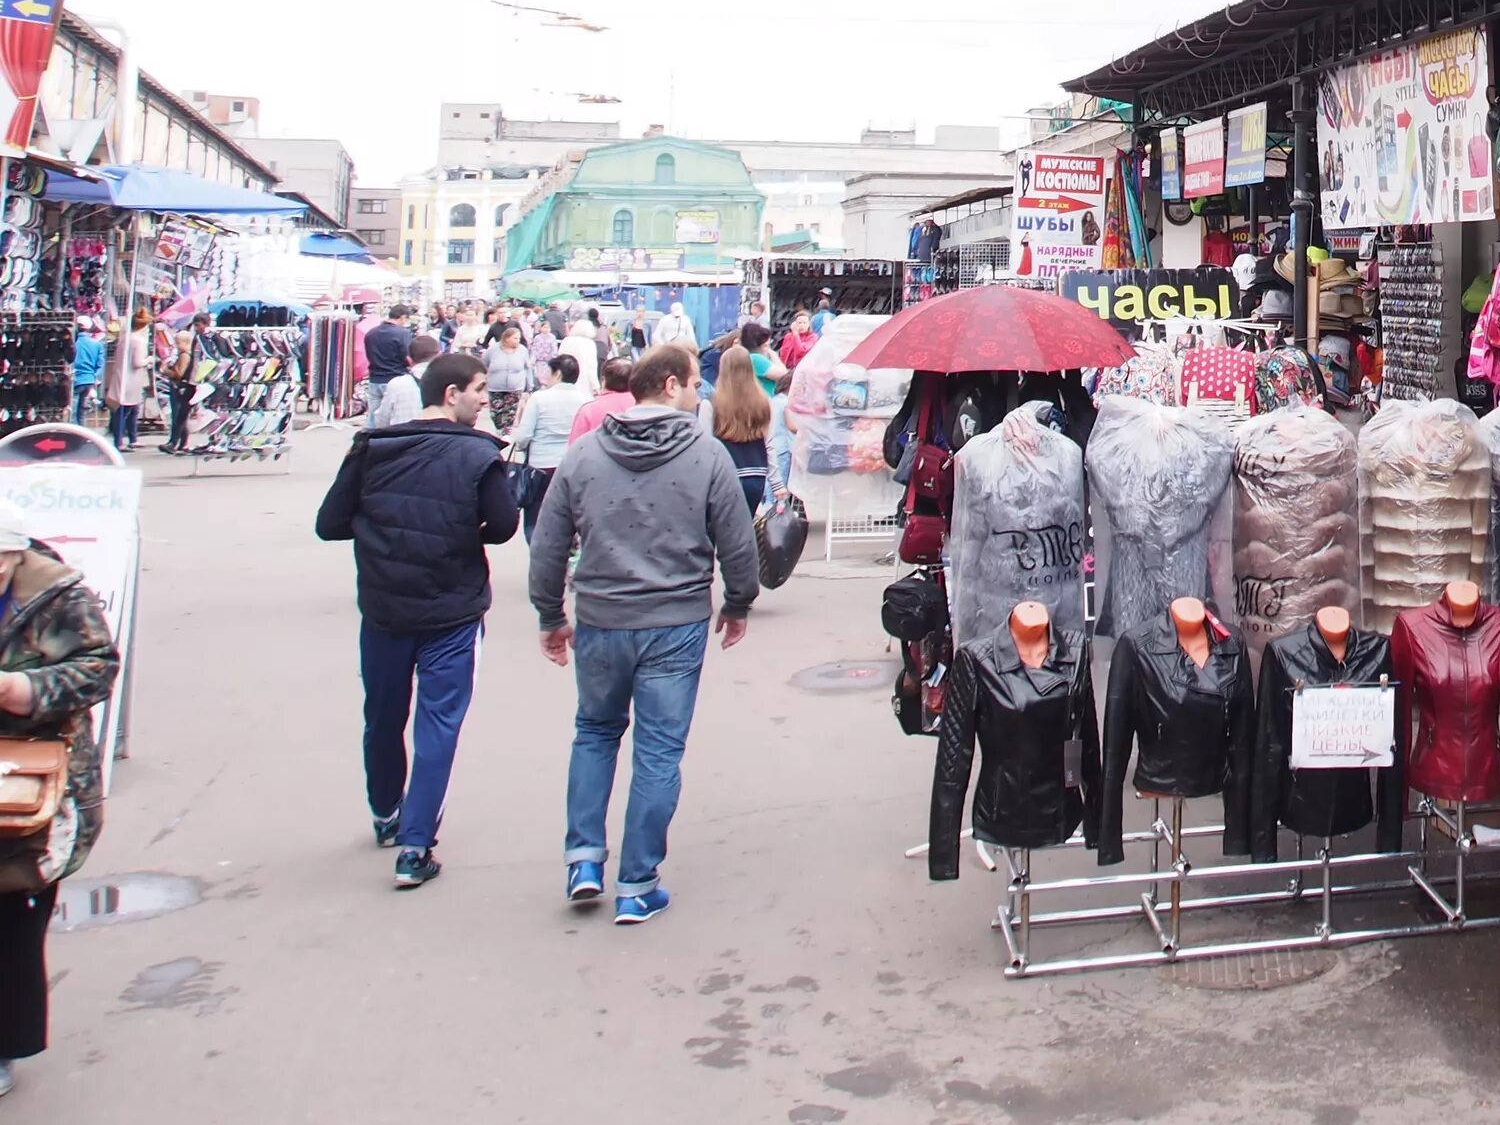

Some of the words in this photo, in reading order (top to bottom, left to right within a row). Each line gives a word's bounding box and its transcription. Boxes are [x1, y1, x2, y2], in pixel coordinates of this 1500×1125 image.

[1428, 62, 1471, 99] ЧАСЫ
[1436, 99, 1467, 123] СУМКИ
[1040, 157, 1097, 171] МУЖСКИЕ
[1036, 171, 1100, 192] КОСТЮМЫ
[1038, 200, 1046, 208] 2
[1017, 216, 1075, 232] ШУБЫ
[1036, 246, 1094, 258] НАРЯДНЫЕ
[1312, 738, 1362, 752] ЦЕНЫ
